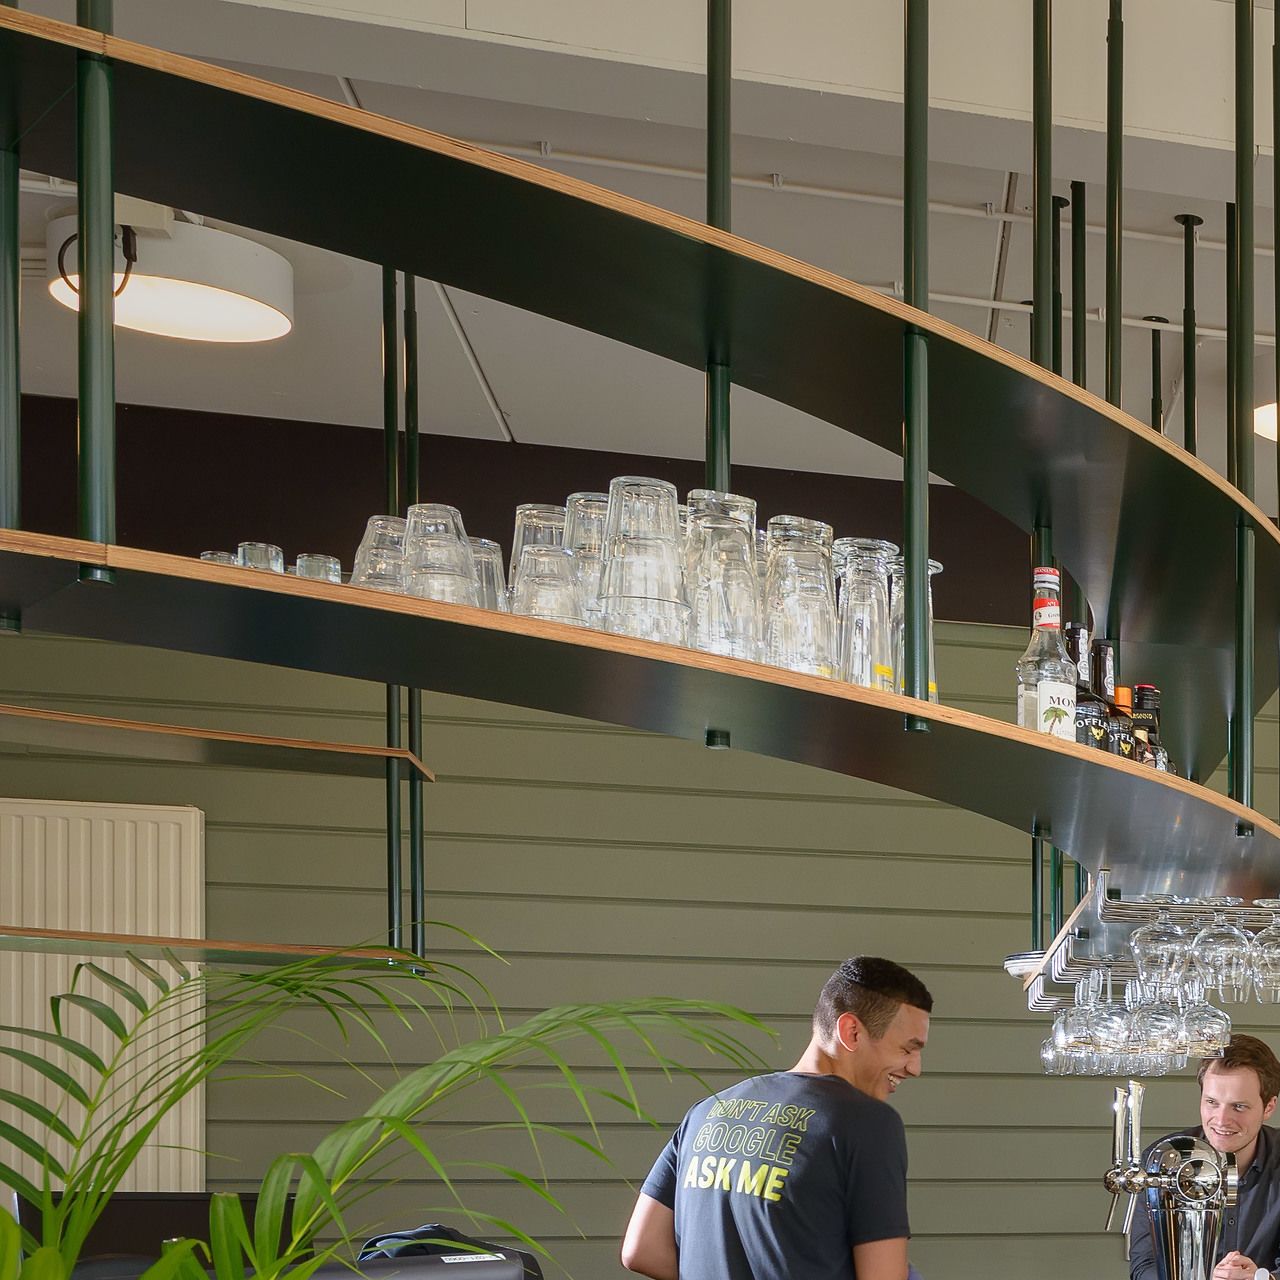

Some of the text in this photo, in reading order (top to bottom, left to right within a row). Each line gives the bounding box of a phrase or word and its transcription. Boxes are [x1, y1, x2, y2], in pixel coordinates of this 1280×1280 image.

[1049, 695, 1076, 708] MON
[706, 1098, 817, 1133] DON'T ASK
[692, 1121, 802, 1166] GOOGLE
[683, 1155, 790, 1202] ASK ME
